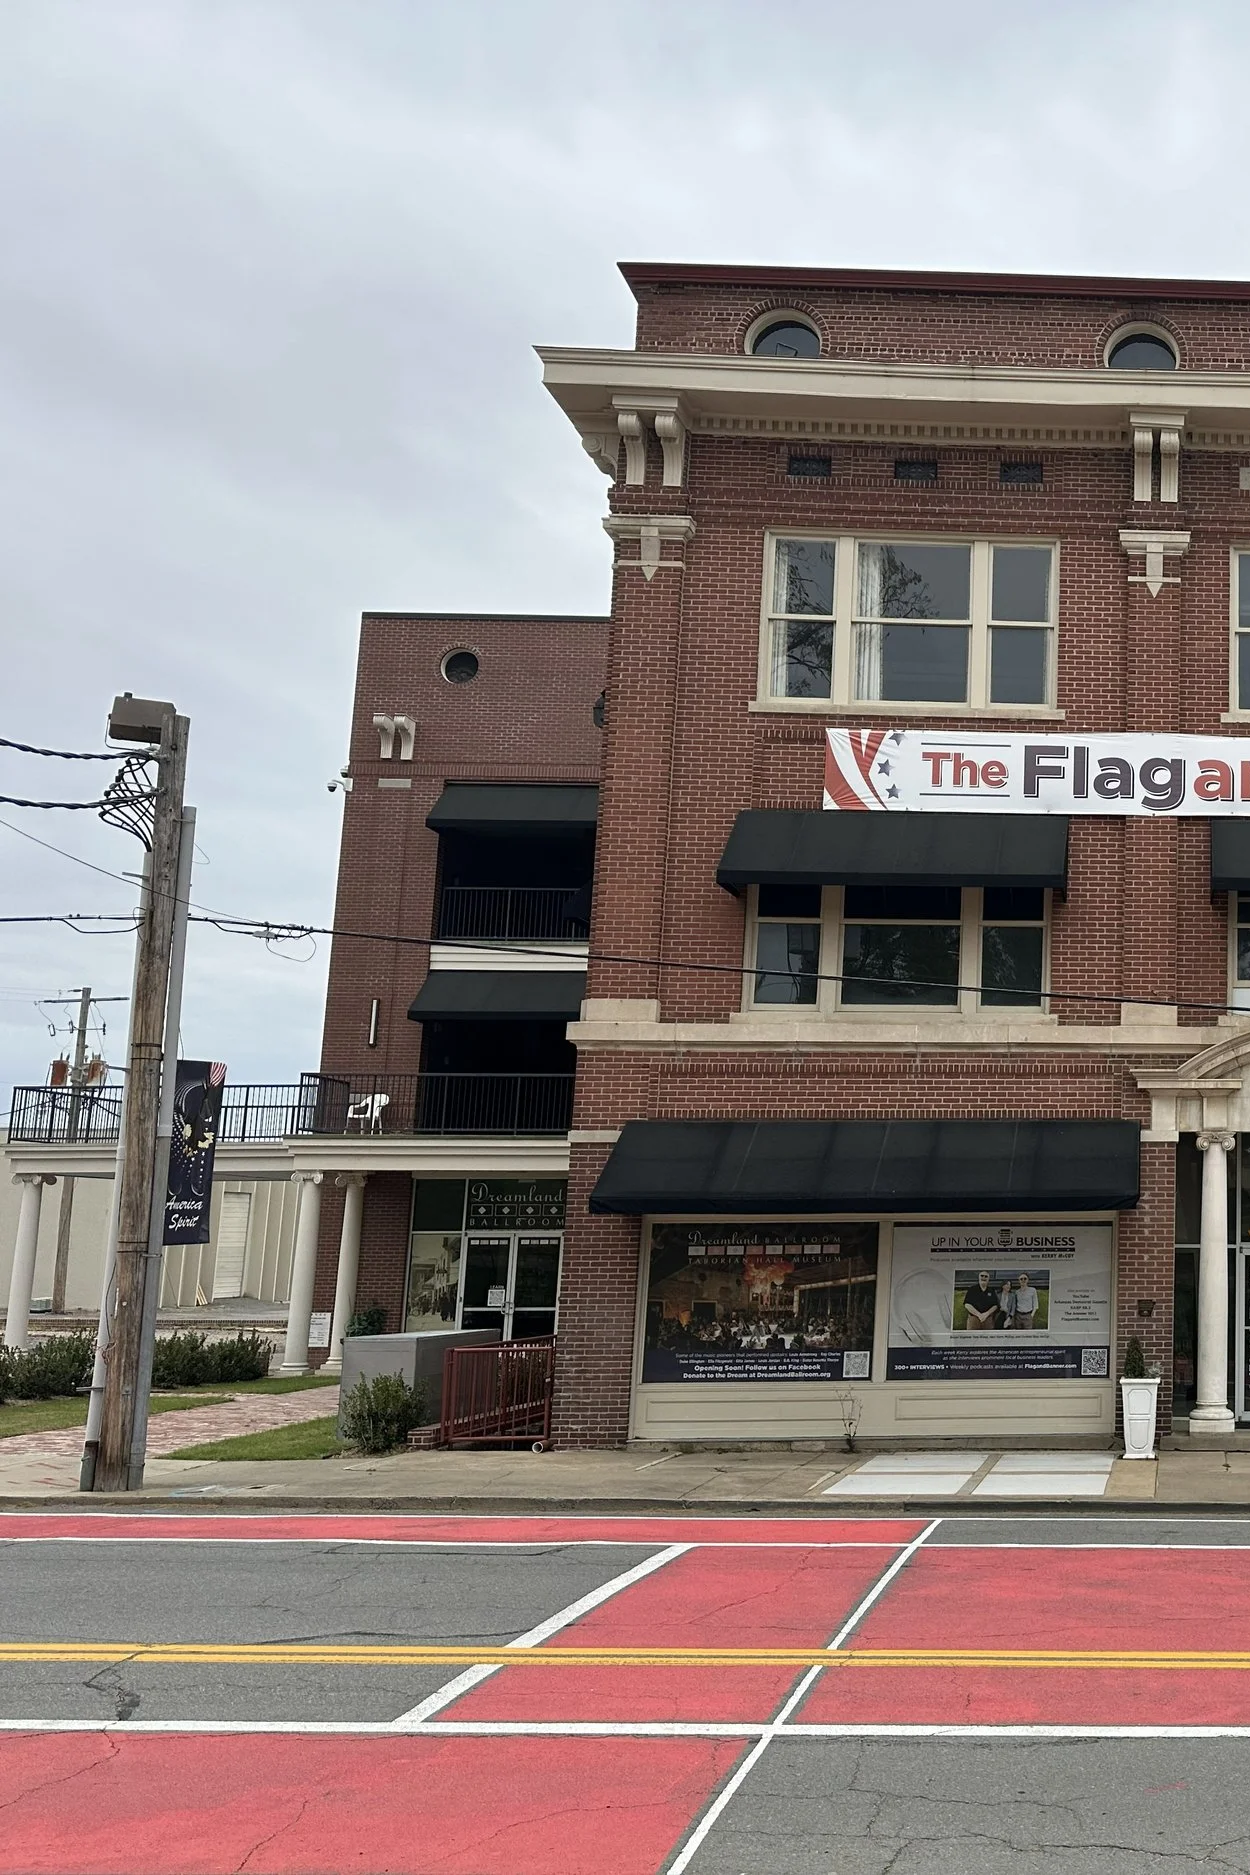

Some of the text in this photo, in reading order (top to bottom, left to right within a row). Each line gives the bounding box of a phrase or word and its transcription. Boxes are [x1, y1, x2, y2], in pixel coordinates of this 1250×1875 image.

[922, 751, 1009, 789] The
[471, 1182, 563, 1202] Dreamland
[168, 1213, 200, 1231] Spirit
[469, 1218, 564, 1226] BALLROOM
[687, 1230, 842, 1246] Dreamland BALLROOM
[931, 1236, 1076, 1247] UP IN YOUR BUSINESS
[687, 1255, 842, 1265] TABORIAN HALL MUSEUM
[694, 1364, 723, 1372] Opening
[756, 1371, 832, 1379] DreamlandBallroom.org
